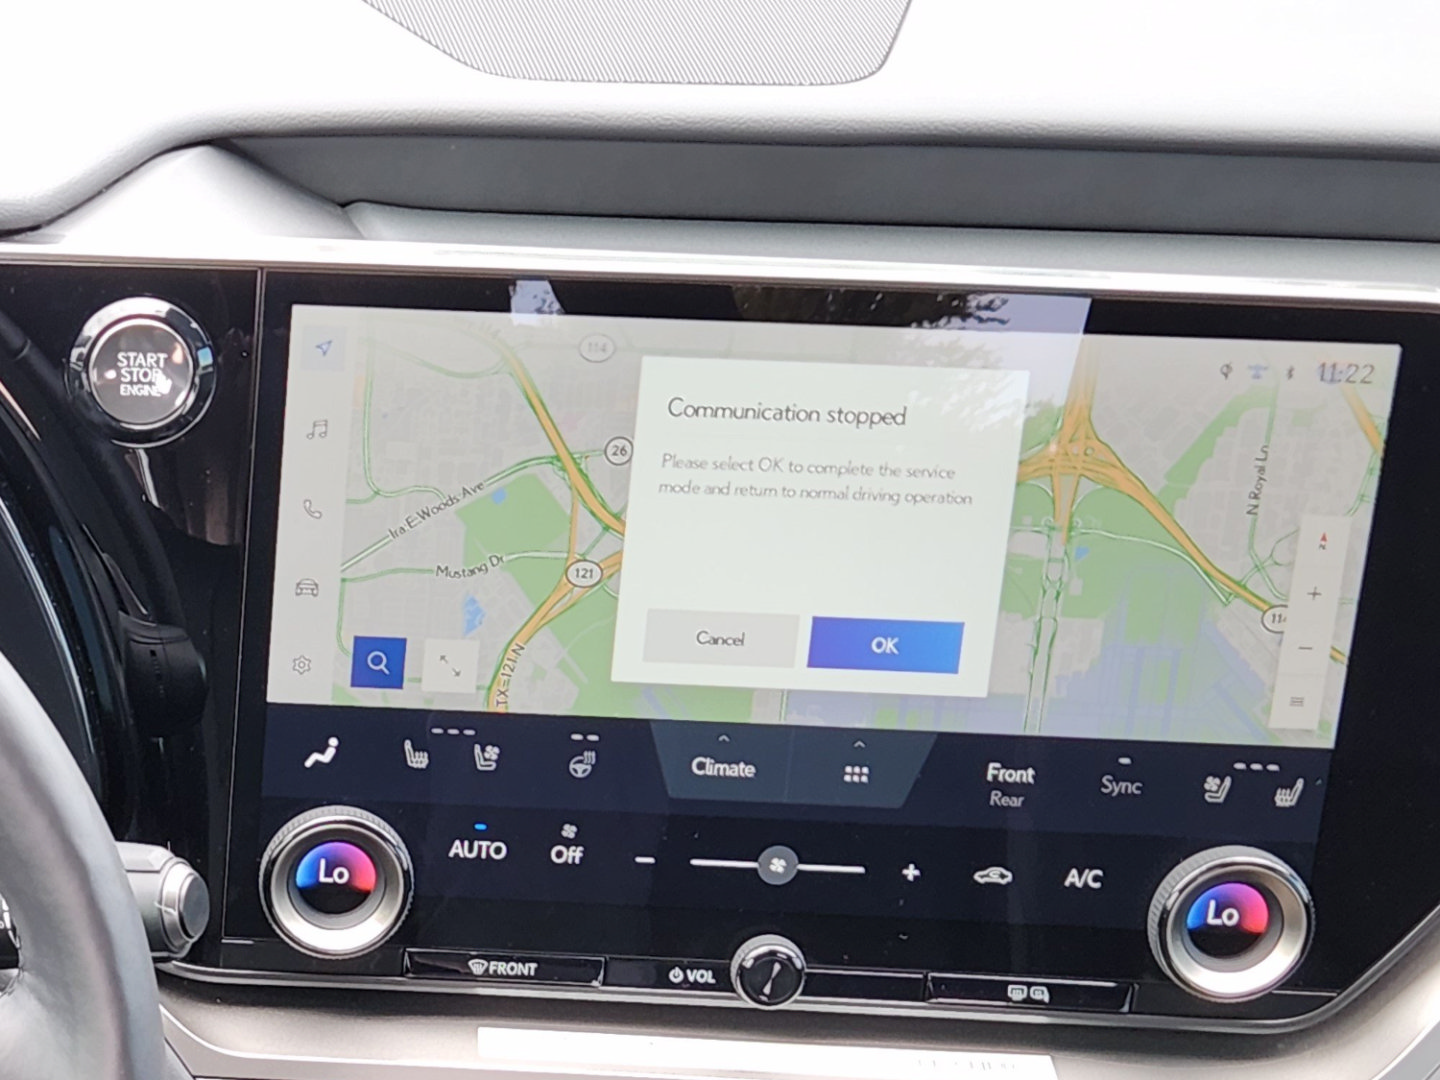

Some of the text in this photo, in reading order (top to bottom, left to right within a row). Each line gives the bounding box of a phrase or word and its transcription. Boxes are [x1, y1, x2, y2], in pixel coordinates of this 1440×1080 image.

[117, 352, 168, 367] START
[120, 368, 164, 383] STOP
[1319, 362, 1375, 384] 11:22
[667, 396, 907, 429] Communication stopped
[611, 444, 628, 457] 26
[661, 453, 956, 480] Please select OK to complete the service
[1246, 444, 1268, 515] N Royal Ln
[658, 480, 973, 506] mode and return to normal driving operation
[388, 481, 484, 539] Ira E Woods Ave
[435, 554, 505, 579] Mustang Dr
[575, 567, 594, 580] 121
[511, 642, 525, 657] N
[695, 630, 745, 648] Cancel
[871, 636, 899, 654] OK
[691, 757, 756, 779] Climate
[986, 763, 1035, 785] Front
[1101, 775, 1143, 796] Sync
[990, 790, 1024, 809] Rear
[448, 839, 507, 861] AUTO
[551, 845, 584, 865] Off
[319, 858, 349, 884] Lo
[1064, 867, 1104, 889] A/C
[1207, 900, 1239, 926] Lo
[488, 959, 538, 976] FRONT
[686, 969, 716, 984] VOL
